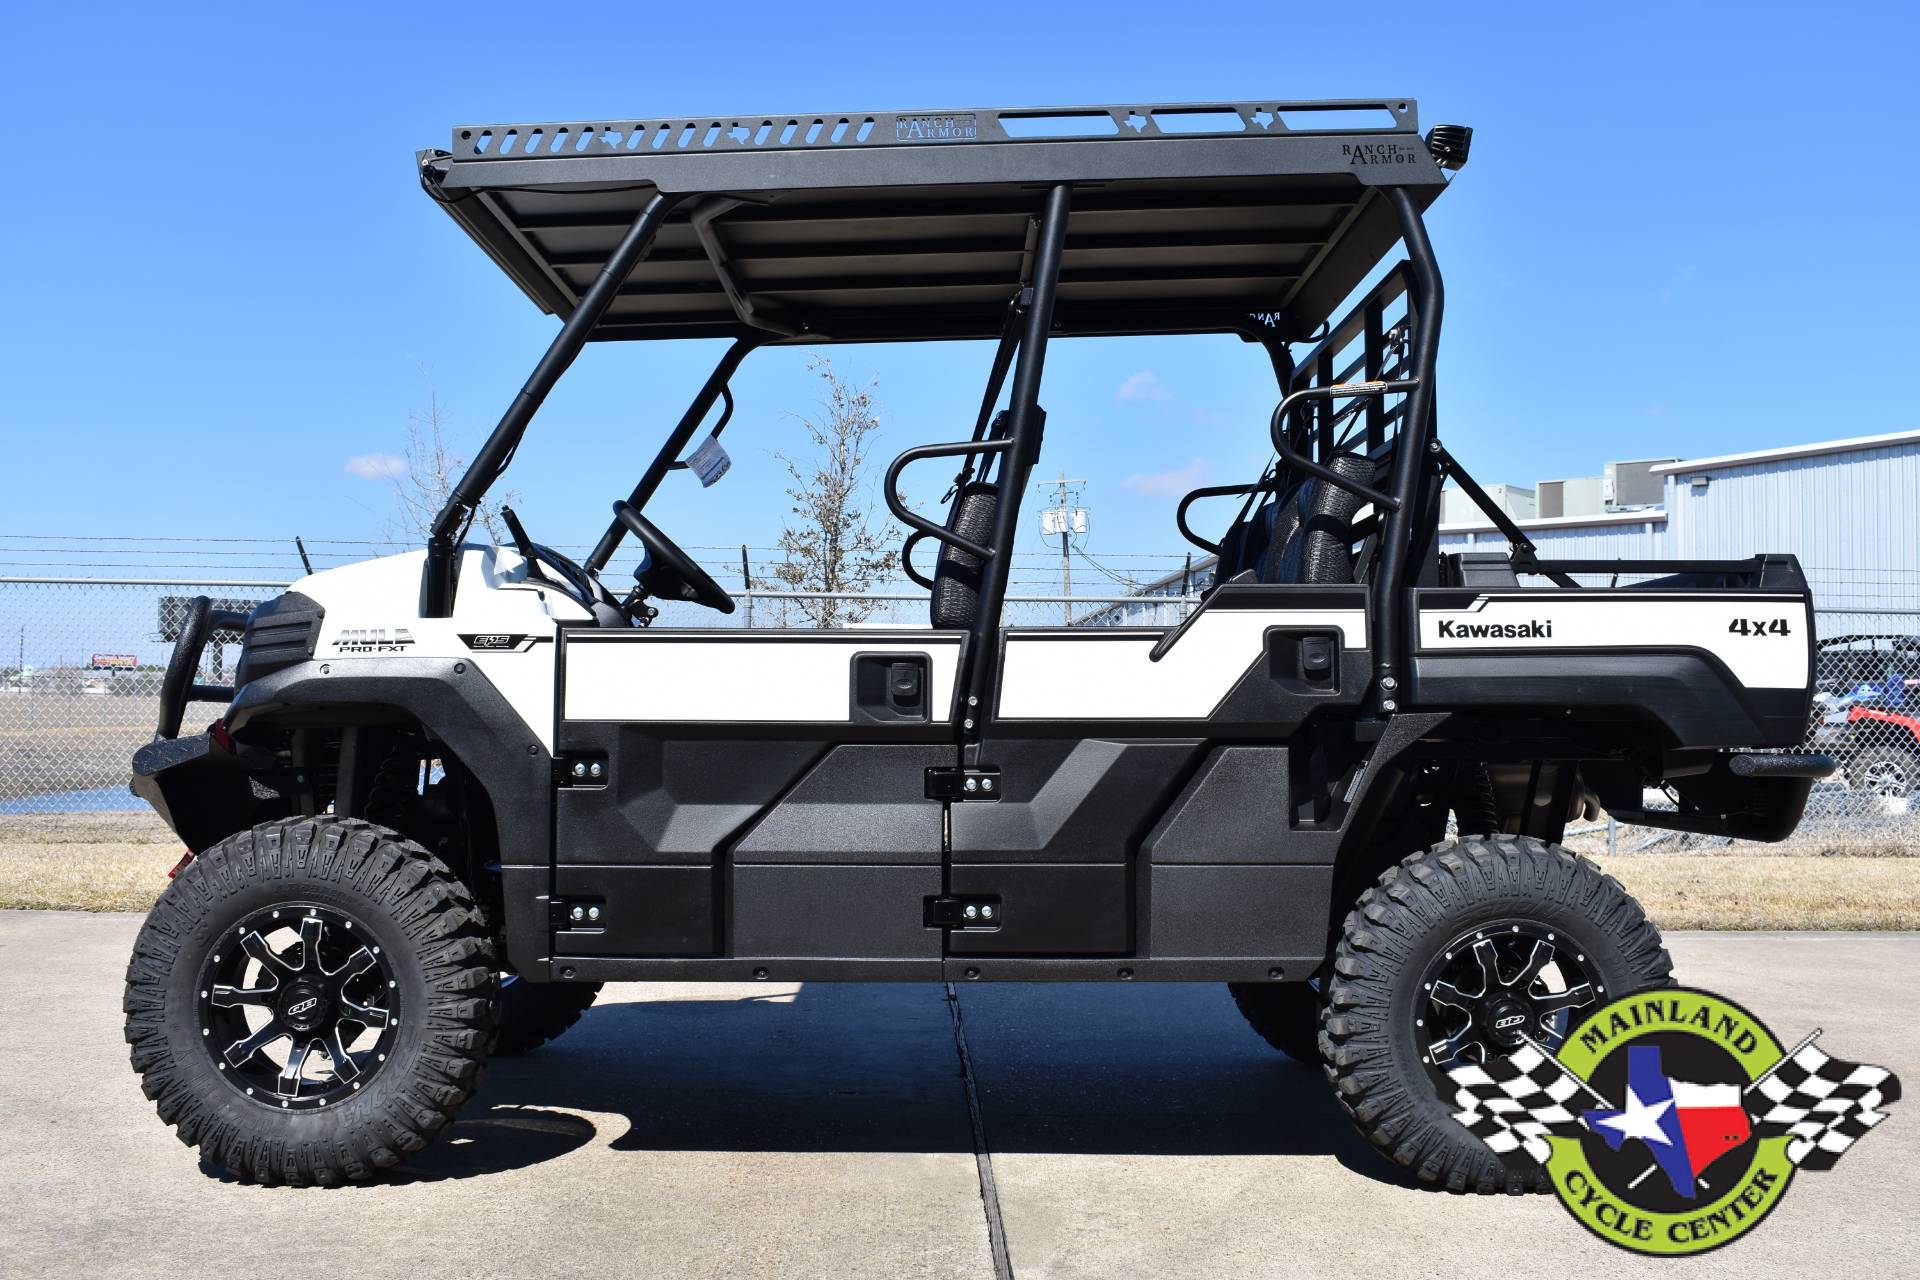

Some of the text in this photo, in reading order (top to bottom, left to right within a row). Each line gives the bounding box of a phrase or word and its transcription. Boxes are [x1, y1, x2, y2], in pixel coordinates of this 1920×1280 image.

[896, 117, 954, 138] RANCH
[906, 118, 974, 138] ARMOR
[1342, 144, 1397, 164] RANCH
[1350, 145, 1416, 164] ARMOR
[1438, 619, 1552, 638] Kawasaki
[1728, 618, 1791, 636] 4x4
[332, 628, 416, 646] MULE
